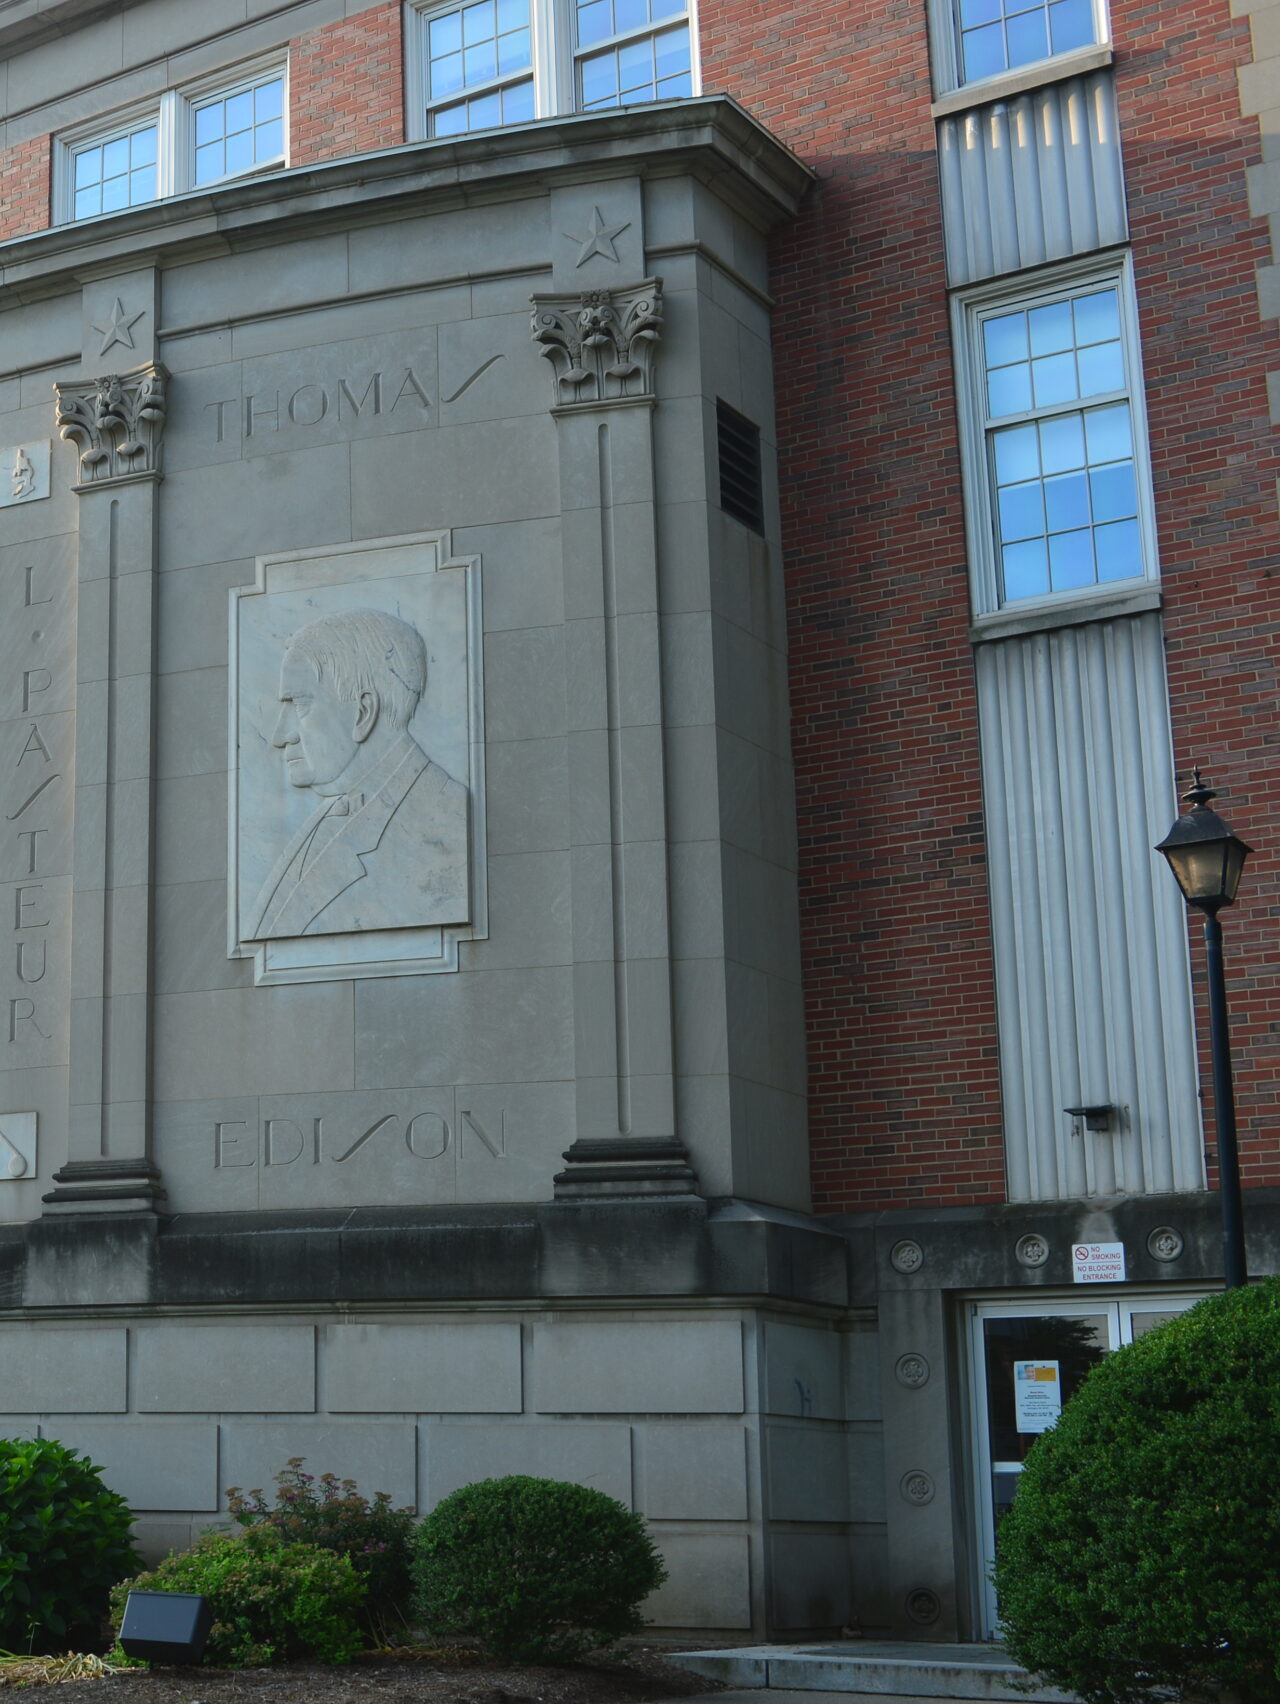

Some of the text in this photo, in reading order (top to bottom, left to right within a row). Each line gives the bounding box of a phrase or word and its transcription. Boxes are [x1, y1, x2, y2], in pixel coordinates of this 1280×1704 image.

[204, 353, 509, 444] THOMAS
[5, 667, 63, 1044] PASTEUR
[214, 1108, 506, 1170] EDISON
[1077, 1263, 1121, 1273] NO BLOCKING
[1091, 1252, 1121, 1261] SMOKING
[1082, 1272, 1118, 1281] ENTRANCE
